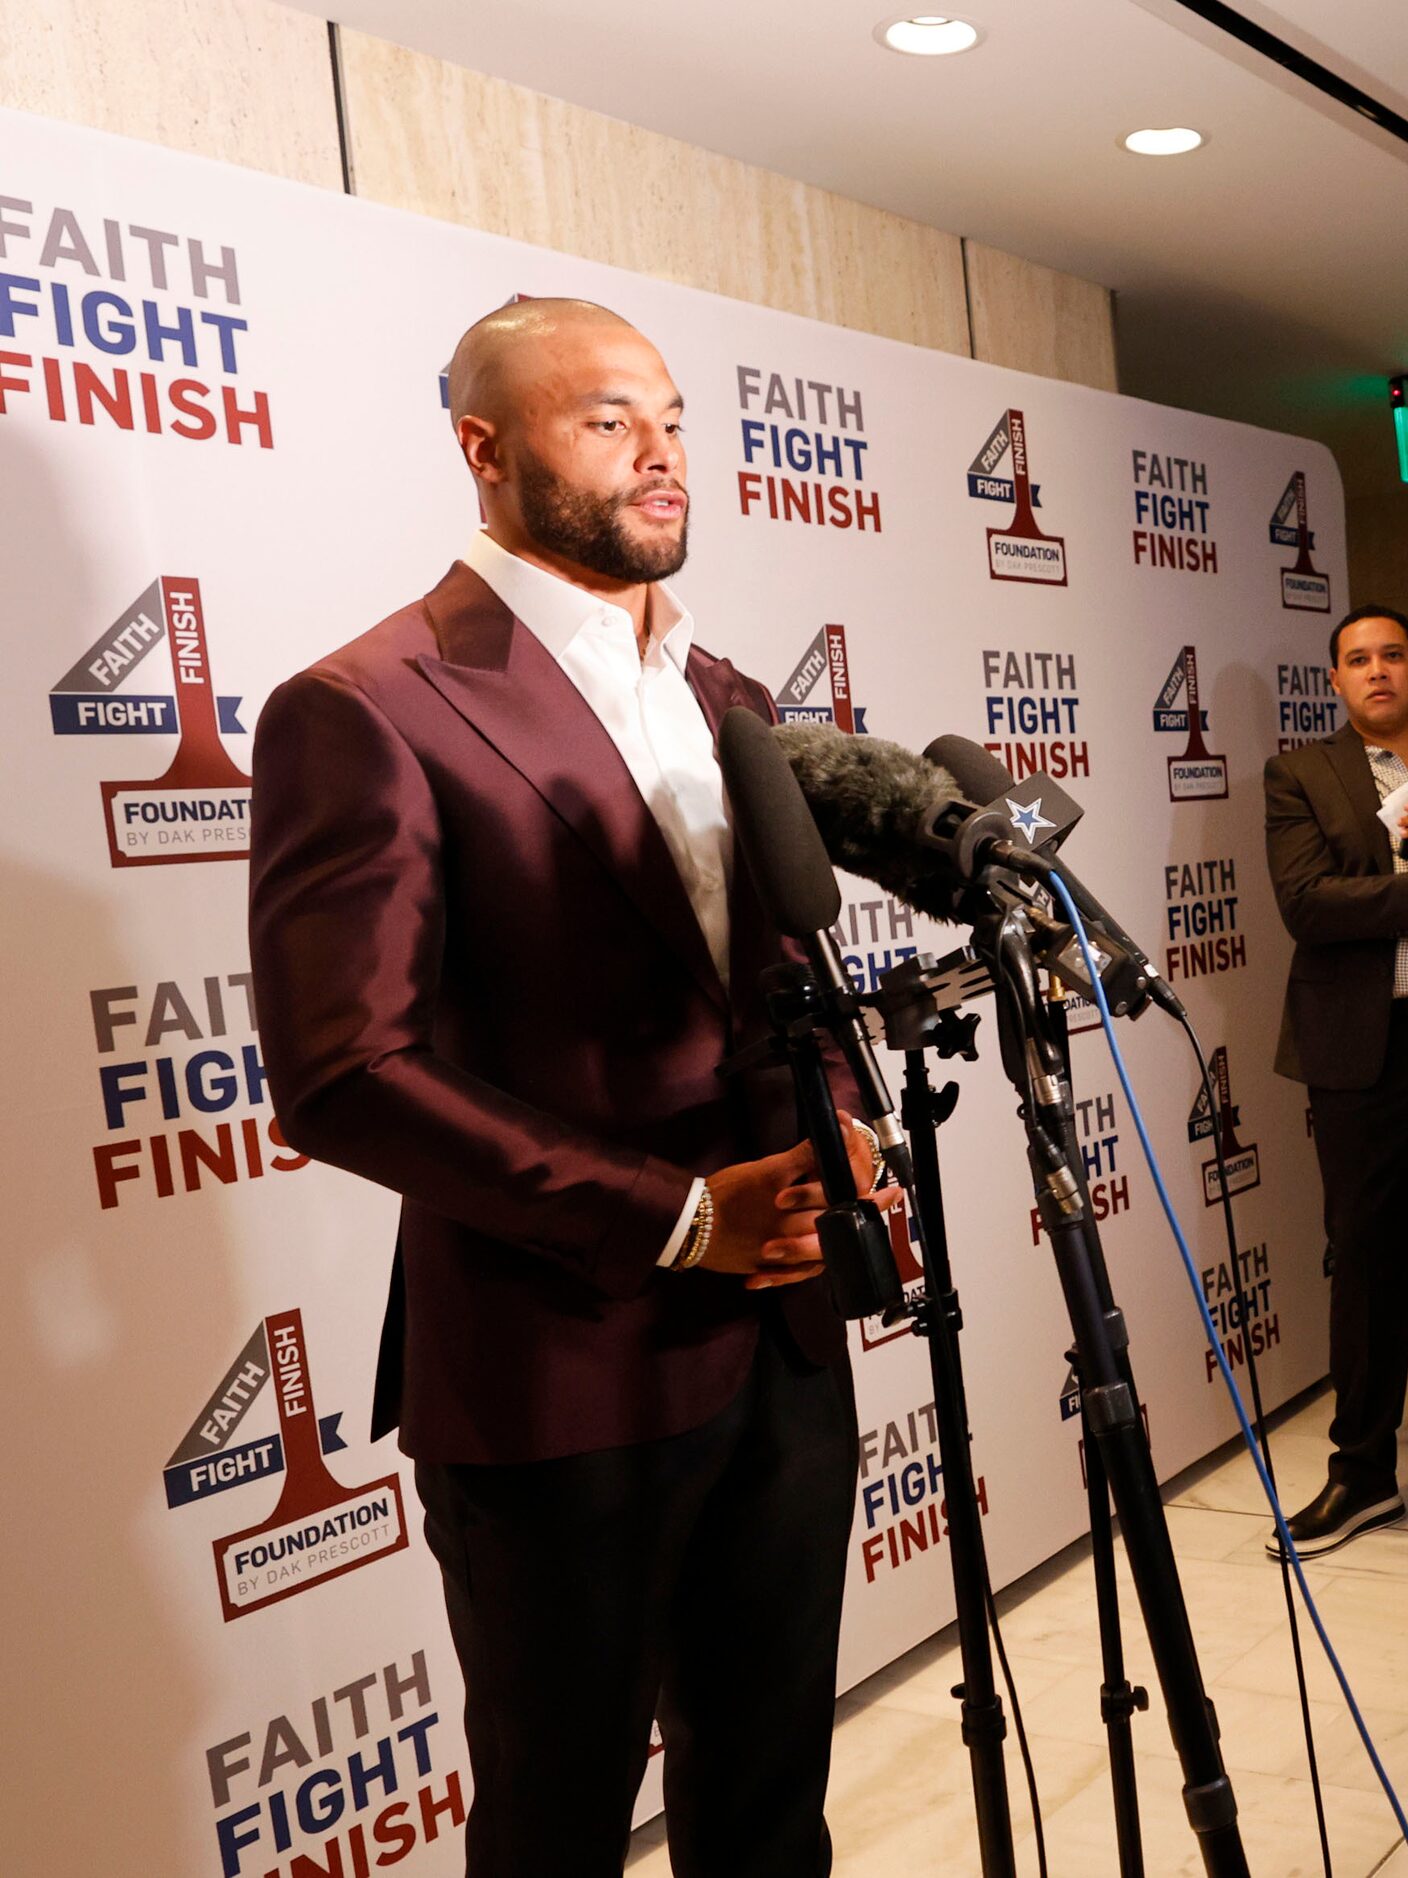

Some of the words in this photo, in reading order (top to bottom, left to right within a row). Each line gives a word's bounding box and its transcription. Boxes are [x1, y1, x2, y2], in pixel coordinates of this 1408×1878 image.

[0, 194, 241, 305] FAITH
[0, 272, 249, 375] FIGHT
[0, 350, 274, 450] FINISH
[737, 365, 864, 432] FAITH
[741, 419, 868, 481] FIGHT
[980, 429, 1008, 472] FAITH
[1011, 419, 1026, 476] FINISH
[1132, 449, 1208, 495] FAITH
[738, 471, 882, 533] FINISH
[976, 478, 1012, 499] FIGHT
[1135, 490, 1210, 534] FIGHT
[994, 541, 1060, 562] FOUNDATION
[1133, 530, 1218, 574] FINISH
[88, 612, 160, 686] FAITH
[170, 591, 204, 684] FINISH
[790, 650, 825, 701] FAITH
[829, 634, 848, 700] FINISH
[983, 651, 1076, 690] FAITH
[1163, 667, 1184, 705] FAITH
[77, 701, 167, 727] FIGHT
[986, 696, 1079, 735] FIGHT
[1160, 713, 1187, 728] FIGHT
[1280, 701, 1337, 733] FIGHT
[1173, 765, 1223, 780] FOUNDATION
[124, 799, 251, 825] FOUNDAT
[127, 832, 149, 847] BY
[159, 829, 195, 845] DAK
[203, 826, 250, 841] PRES
[1165, 859, 1236, 900] FAITH
[1168, 897, 1238, 940] FIGHT
[1166, 934, 1246, 982] FINISH
[90, 972, 259, 1054] FAIT
[100, 1044, 269, 1130] FIGH
[93, 1117, 311, 1210] FINIS
[1202, 1243, 1268, 1303] FATH
[273, 1325, 308, 1418] FINISH
[199, 1360, 265, 1446] FAITH
[189, 1443, 273, 1492] FIGHT
[859, 1401, 937, 1479] FAIT
[862, 1453, 943, 1530] FIGH
[234, 1498, 389, 1575] FOUNDATION
[237, 1576, 259, 1597] BY
[266, 1563, 302, 1585] DAK
[307, 1524, 391, 1569] PRESCOTT
[206, 1649, 431, 1809] FAITH
[216, 1712, 439, 1878] FIGHT
